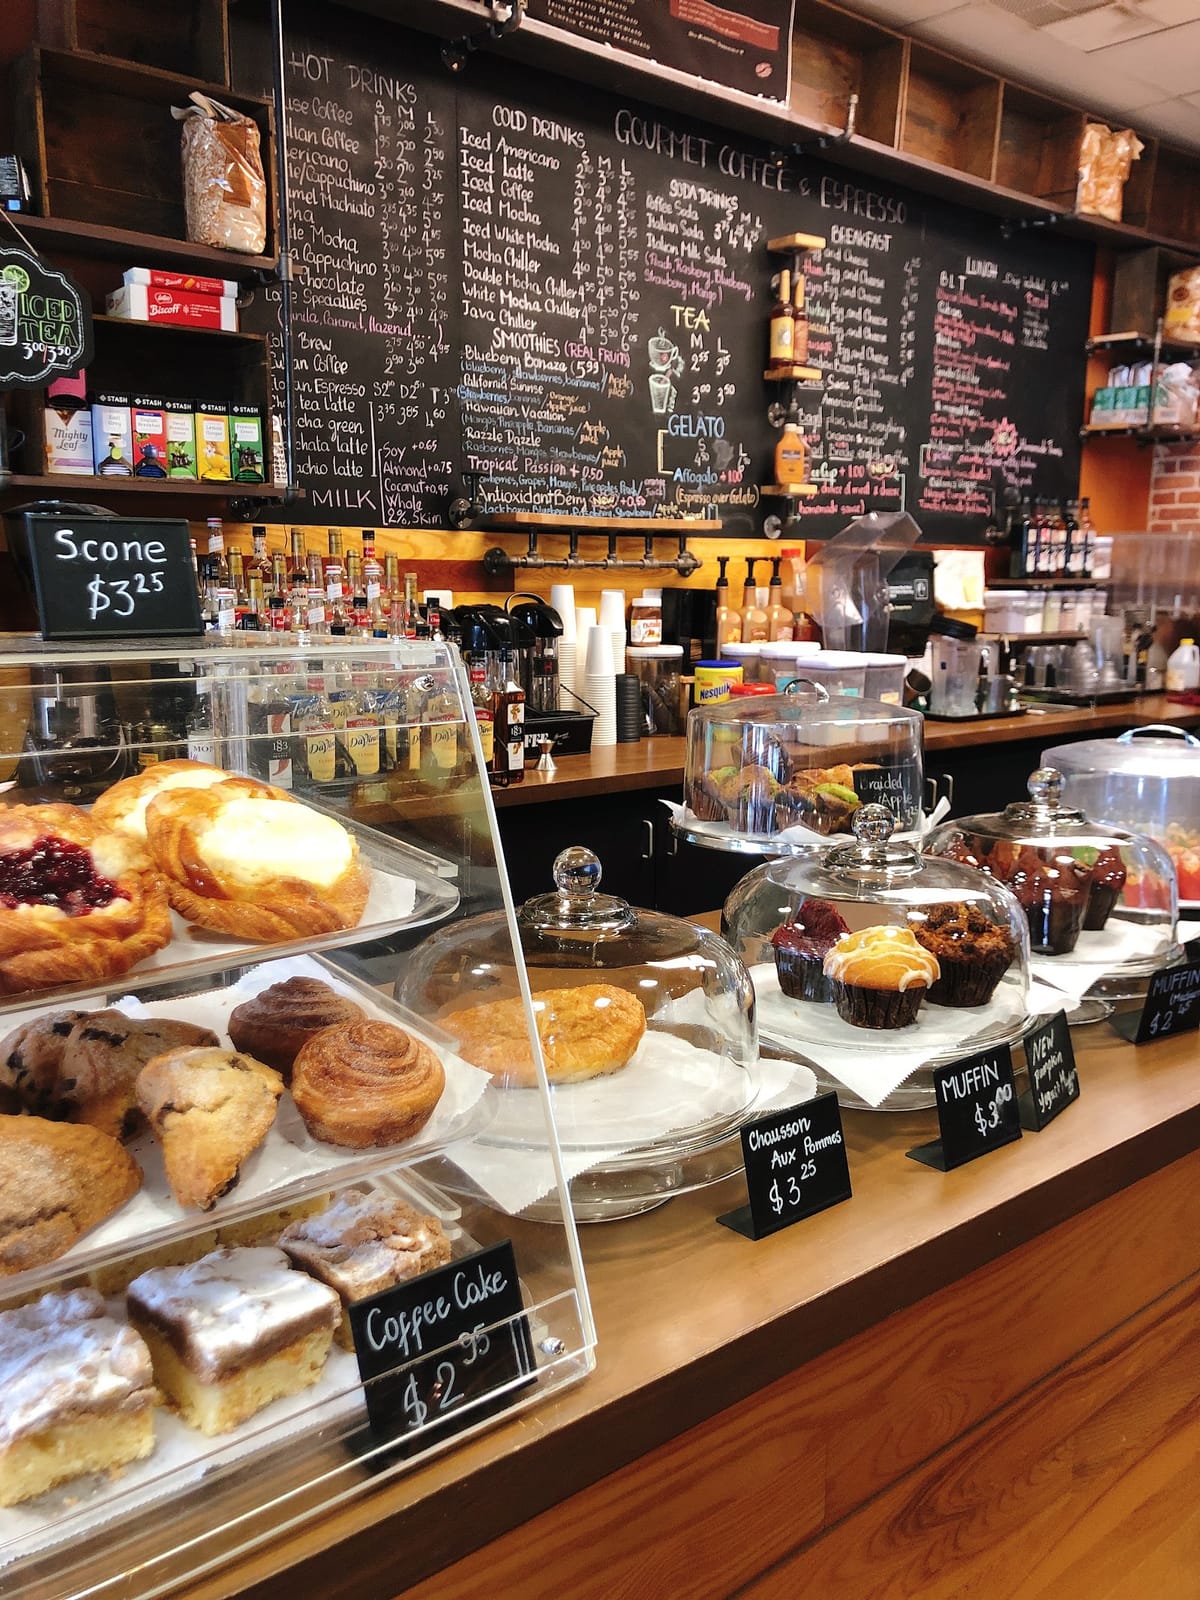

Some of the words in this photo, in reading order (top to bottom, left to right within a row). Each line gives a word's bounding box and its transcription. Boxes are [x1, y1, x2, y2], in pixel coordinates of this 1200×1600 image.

[288, 51, 334, 84] HOT
[344, 65, 417, 104] DRINKS
[312, 97, 353, 126] Coffee
[492, 104, 527, 132] COLD
[532, 116, 586, 149] DRINKS
[321, 127, 360, 155] Coffee
[460, 126, 491, 150] Iced
[496, 136, 560, 170] Americano
[460, 150, 495, 174] Iced
[503, 156, 535, 183] Latte
[615, 109, 713, 168] GOURMET
[719, 145, 791, 193] COFFEE
[820, 176, 907, 224] ESPRESSO
[461, 169, 495, 194] Iced
[500, 179, 534, 203] Coffee
[669, 179, 697, 200] SODA
[698, 187, 739, 211] DRINKS
[461, 190, 493, 216] Iced
[499, 199, 542, 226] Mocha
[645, 194, 673, 215] Coffee
[674, 200, 699, 221] Soda
[311, 223, 360, 255] Mocha
[462, 217, 491, 239] Iced
[494, 223, 526, 245] White
[526, 231, 560, 255] Mocha
[646, 213, 679, 235] Italian
[680, 219, 704, 241] Soda
[831, 224, 893, 253] BREAKFAST
[302, 242, 378, 277] Cappuchino
[463, 238, 502, 264] Mocha
[504, 246, 541, 274] Chiller
[646, 233, 679, 256] Italian
[681, 240, 701, 259] Milk
[704, 245, 727, 268] Soda
[299, 265, 365, 296] Chocolate
[462, 260, 502, 286] Double
[505, 270, 542, 295] Mocha
[545, 276, 577, 299] Chiller
[966, 256, 998, 279] LUNCH
[21, 293, 77, 323] ICED
[149, 303, 182, 316] Biscoff
[462, 281, 496, 303] White
[499, 289, 542, 312] Mocha
[544, 298, 580, 320] Chiller
[462, 300, 496, 322] Java
[499, 308, 537, 331] Chiller
[670, 305, 710, 332] TEA
[18, 319, 79, 349] TEA
[298, 332, 332, 351] Brew
[492, 327, 560, 357] SMOOTHIES
[313, 353, 349, 374] Coffee
[464, 344, 521, 368] Blueberry
[107, 395, 128, 403] STASH
[142, 398, 162, 406] STASH
[300, 394, 320, 412] tea
[314, 378, 366, 402] Espresso
[172, 402, 192, 410] STASH
[207, 404, 226, 412] STASH
[239, 406, 259, 414] STASH
[52, 427, 88, 442] Mighty
[328, 419, 365, 442] green
[465, 427, 503, 443] Razzle
[505, 428, 542, 447] Dazzle
[668, 414, 725, 438] GELATO
[56, 439, 79, 452] Leaf
[336, 433, 368, 456] latte
[383, 441, 407, 462] Soy
[333, 456, 364, 477] latte
[383, 458, 428, 479] Almond
[467, 451, 519, 474] Tropical
[524, 457, 567, 475] Passion
[384, 478, 425, 494] Coconut
[673, 467, 718, 492] Affogato
[312, 488, 377, 510] MILK
[385, 495, 423, 511] Whole
[412, 511, 443, 525] Skim
[54, 529, 168, 563] Scone
[700, 683, 730, 700] Nesquik
[272, 740, 288, 752] 183
[881, 792, 913, 820] Apple
[1152, 969, 1200, 997] MUFFIN
[1032, 1028, 1054, 1066] NEW
[941, 1060, 1000, 1103] MUFFIN
[748, 1116, 811, 1151] Chausson
[771, 1148, 796, 1169] Aux
[803, 1129, 842, 1156] Pommes
[366, 1294, 451, 1356] Coffee
[454, 1264, 508, 1310] Cake
